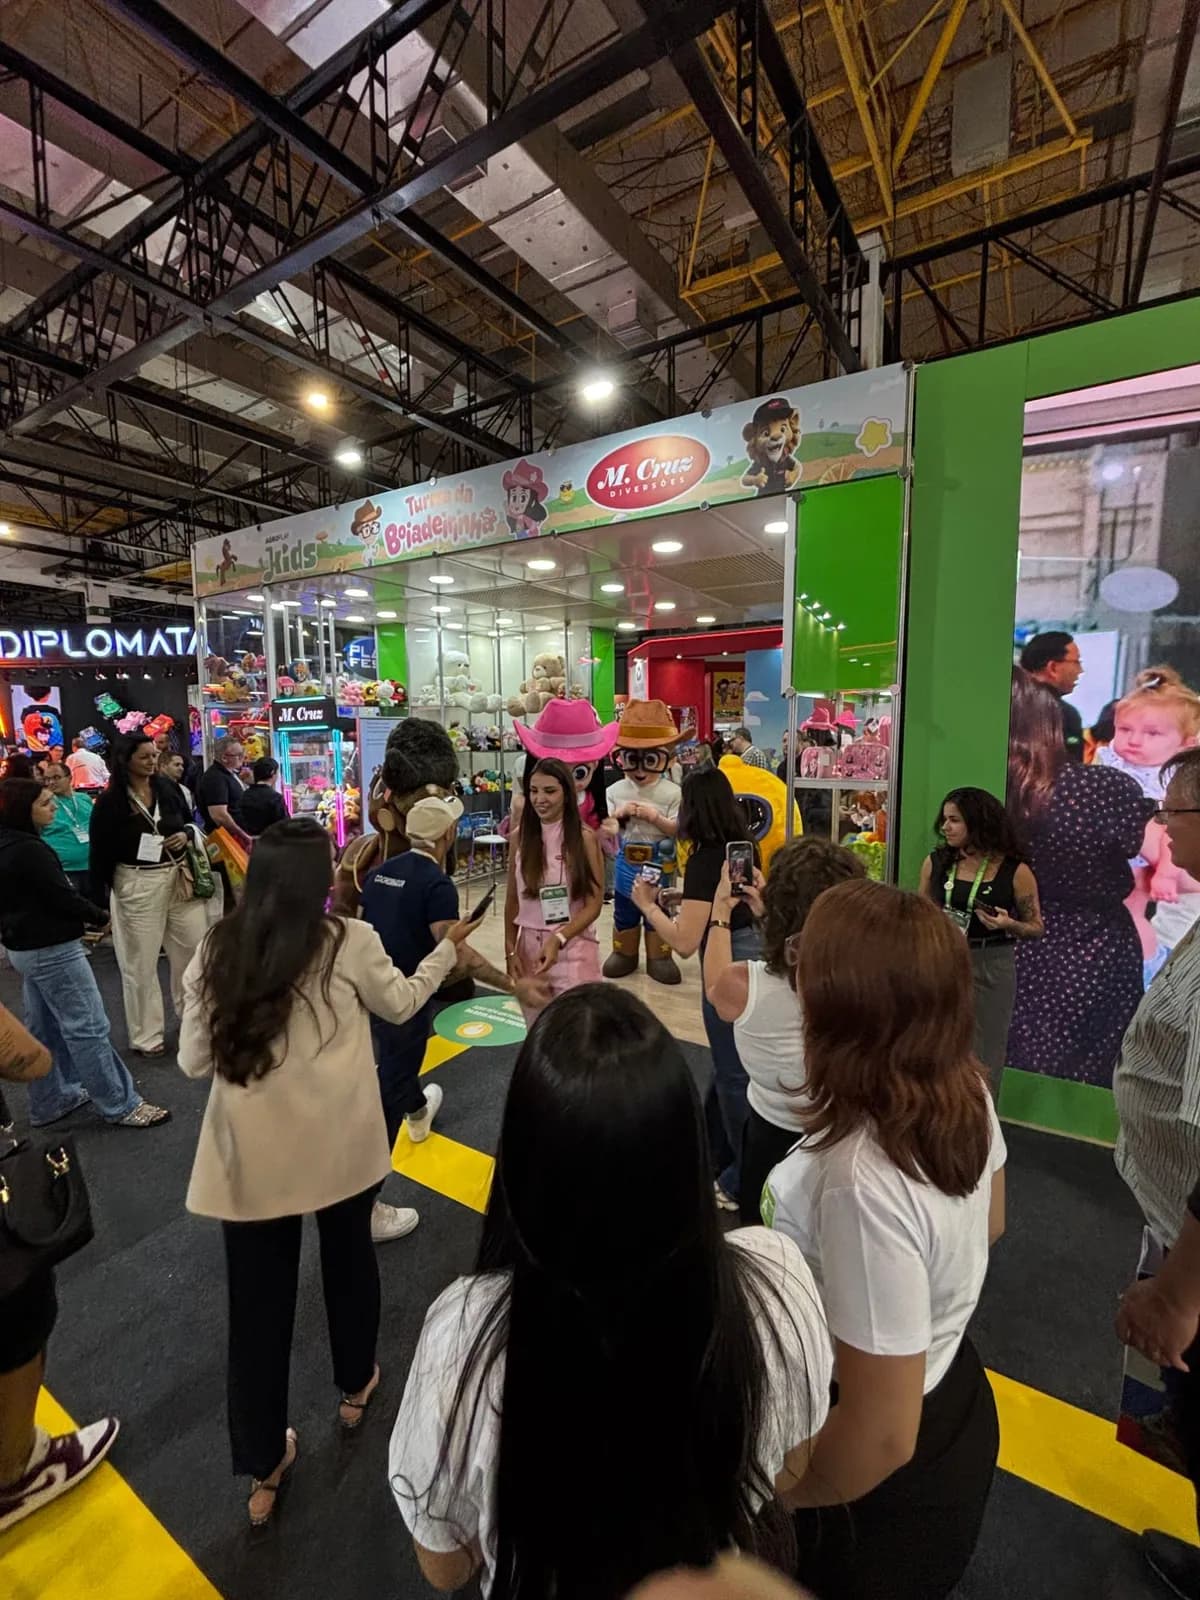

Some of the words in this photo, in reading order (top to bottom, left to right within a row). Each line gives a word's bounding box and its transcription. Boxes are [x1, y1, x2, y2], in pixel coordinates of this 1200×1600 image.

[597, 464, 631, 489] M.
[637, 456, 694, 480] Cruz
[405, 490, 450, 516] Turma
[455, 483, 473, 503] da
[609, 477, 685, 498] DIVERSÕES
[278, 707, 295, 722] M.
[296, 706, 324, 721] Cruz
